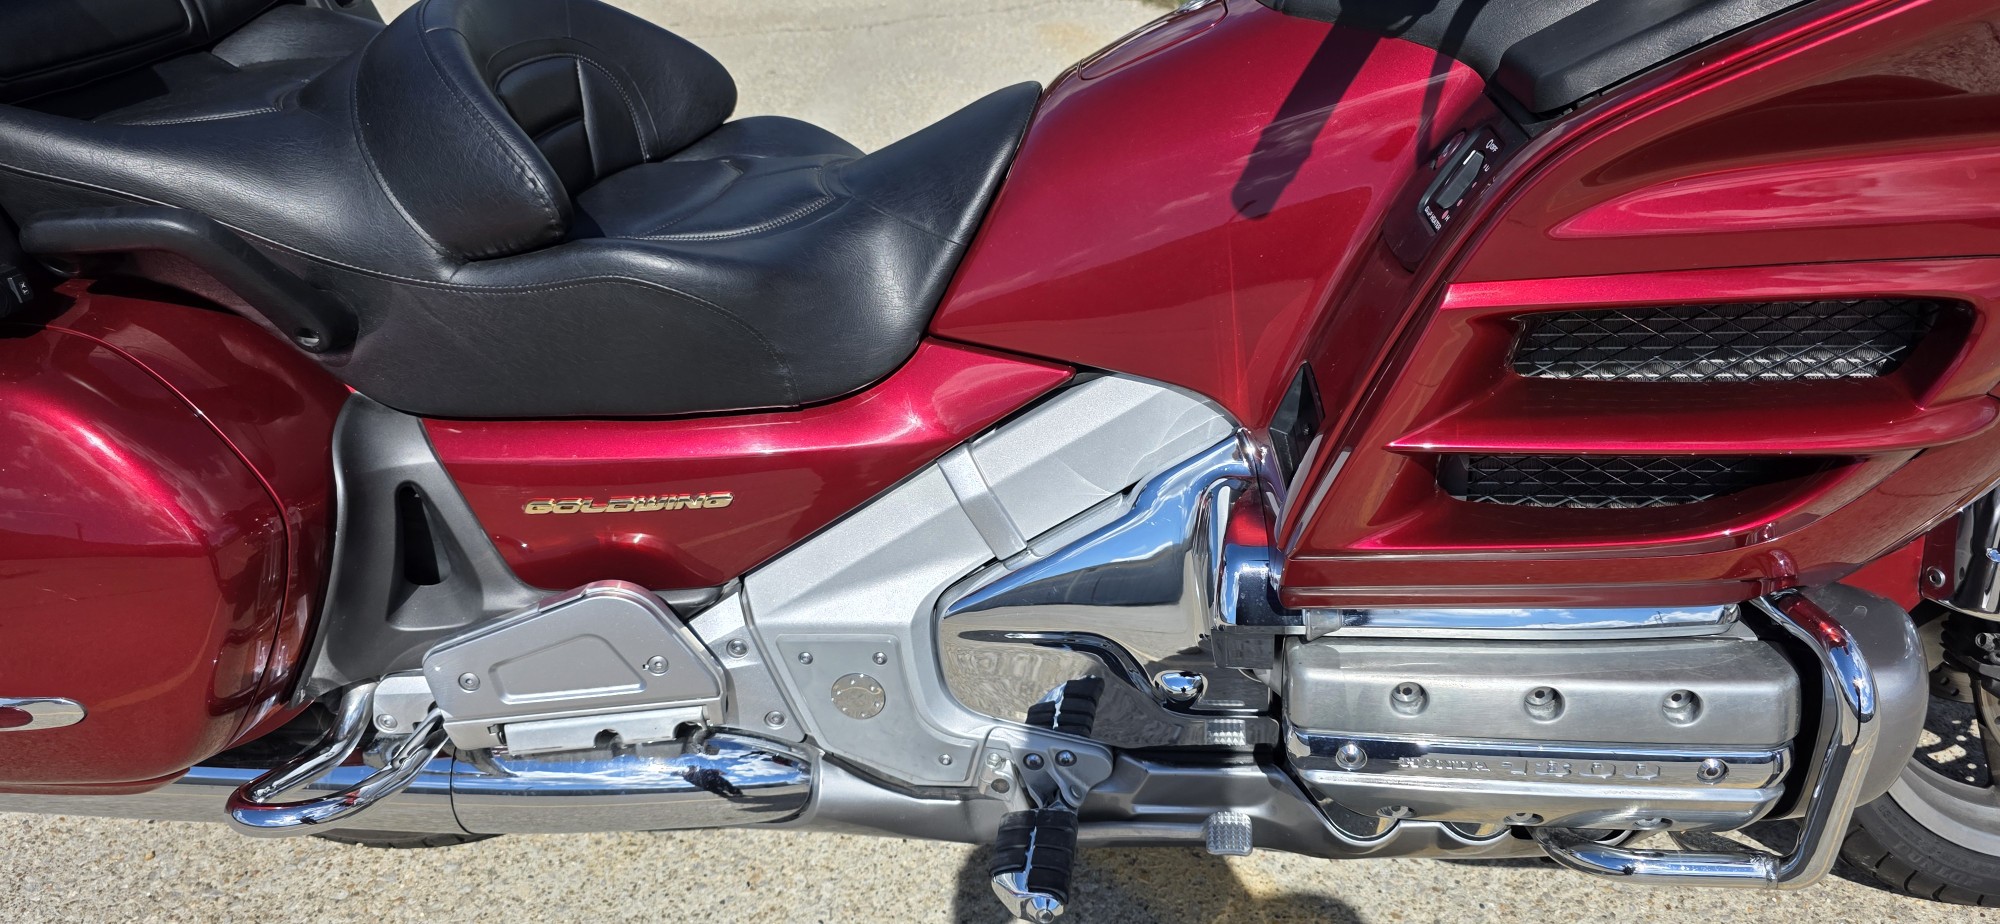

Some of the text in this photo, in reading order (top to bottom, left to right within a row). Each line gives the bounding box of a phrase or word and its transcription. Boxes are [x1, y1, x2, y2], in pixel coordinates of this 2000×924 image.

[524, 491, 734, 515] GOLDWING
[1399, 756, 1662, 780] HONDA 1800
[1893, 840, 1983, 887] DUNLOP
